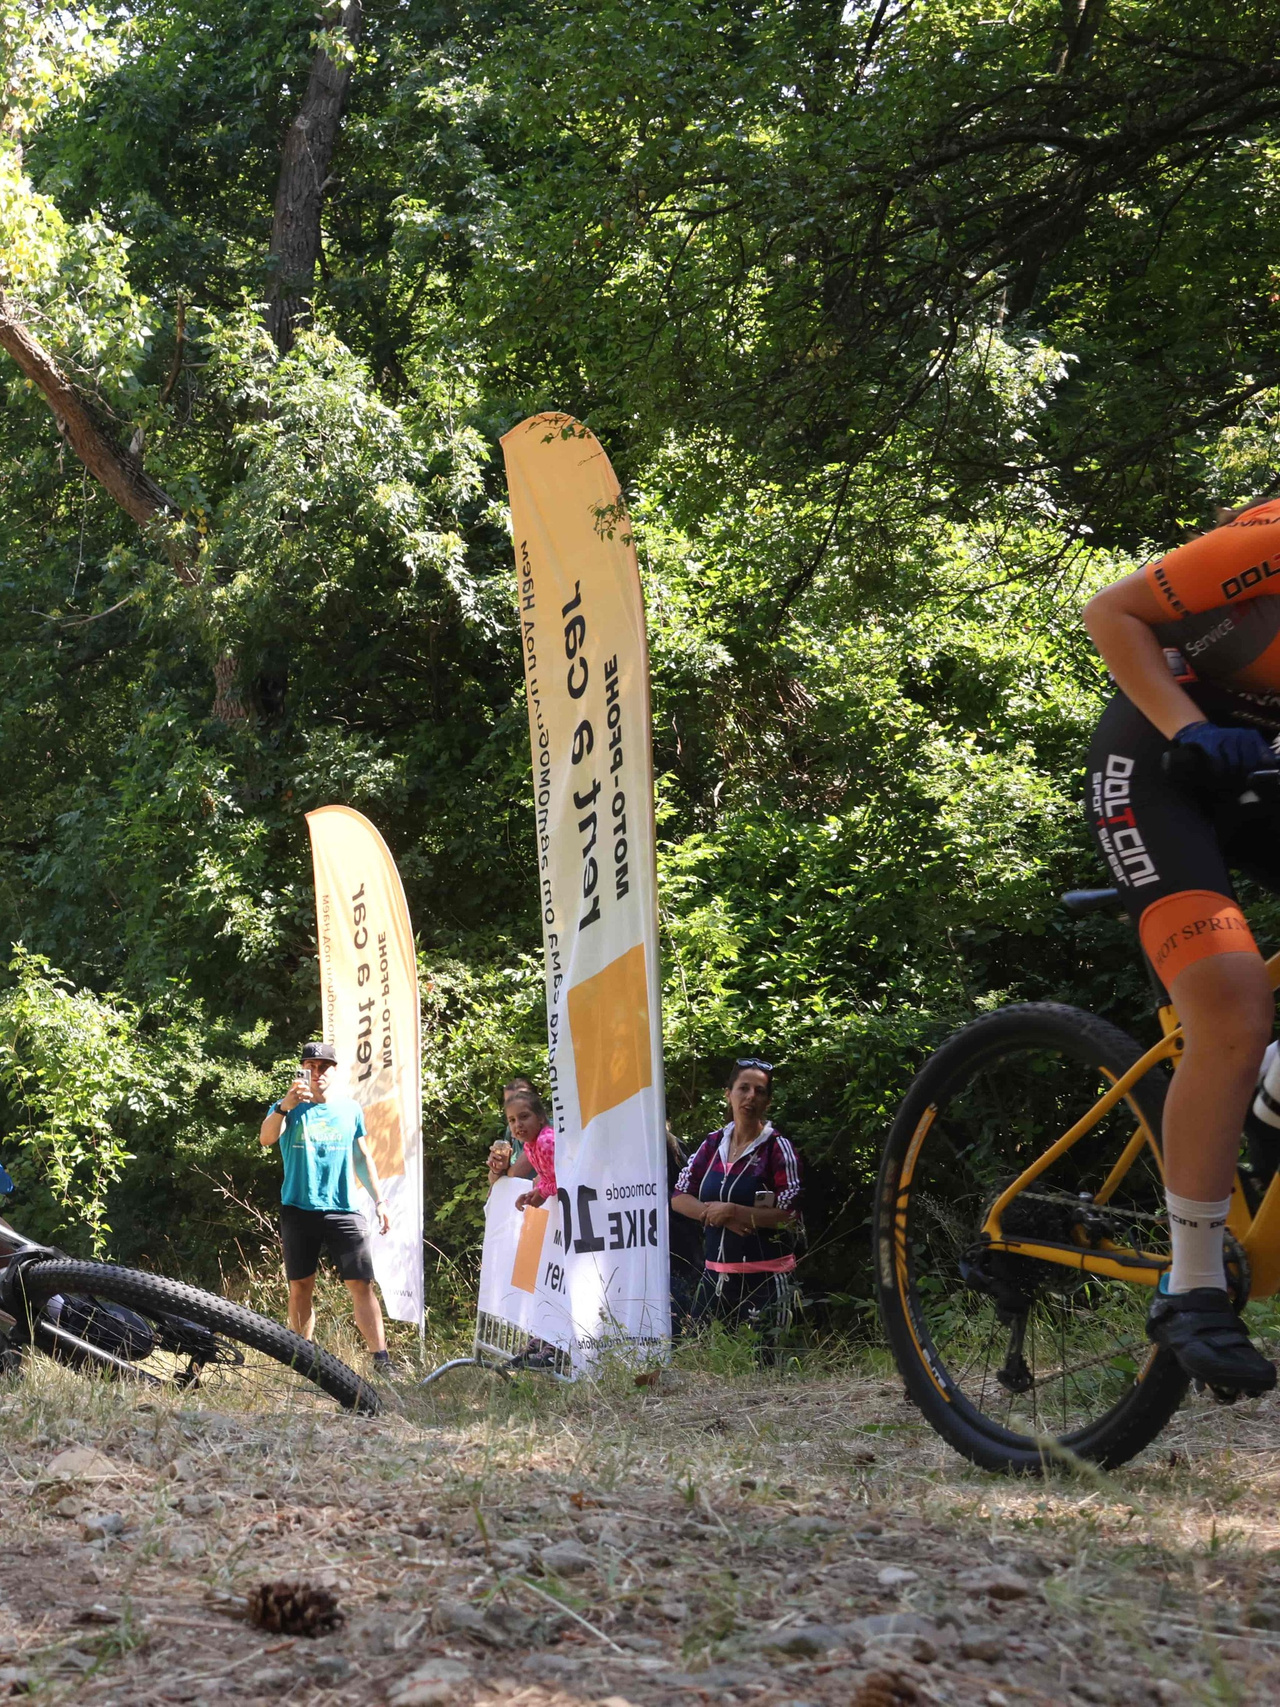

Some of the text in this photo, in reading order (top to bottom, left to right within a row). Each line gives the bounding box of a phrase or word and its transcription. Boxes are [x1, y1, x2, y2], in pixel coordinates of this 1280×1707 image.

[1221, 553, 1280, 600] DOL
[1185, 617, 1235, 657] Service
[1103, 753, 1160, 888] DOLTCINI
